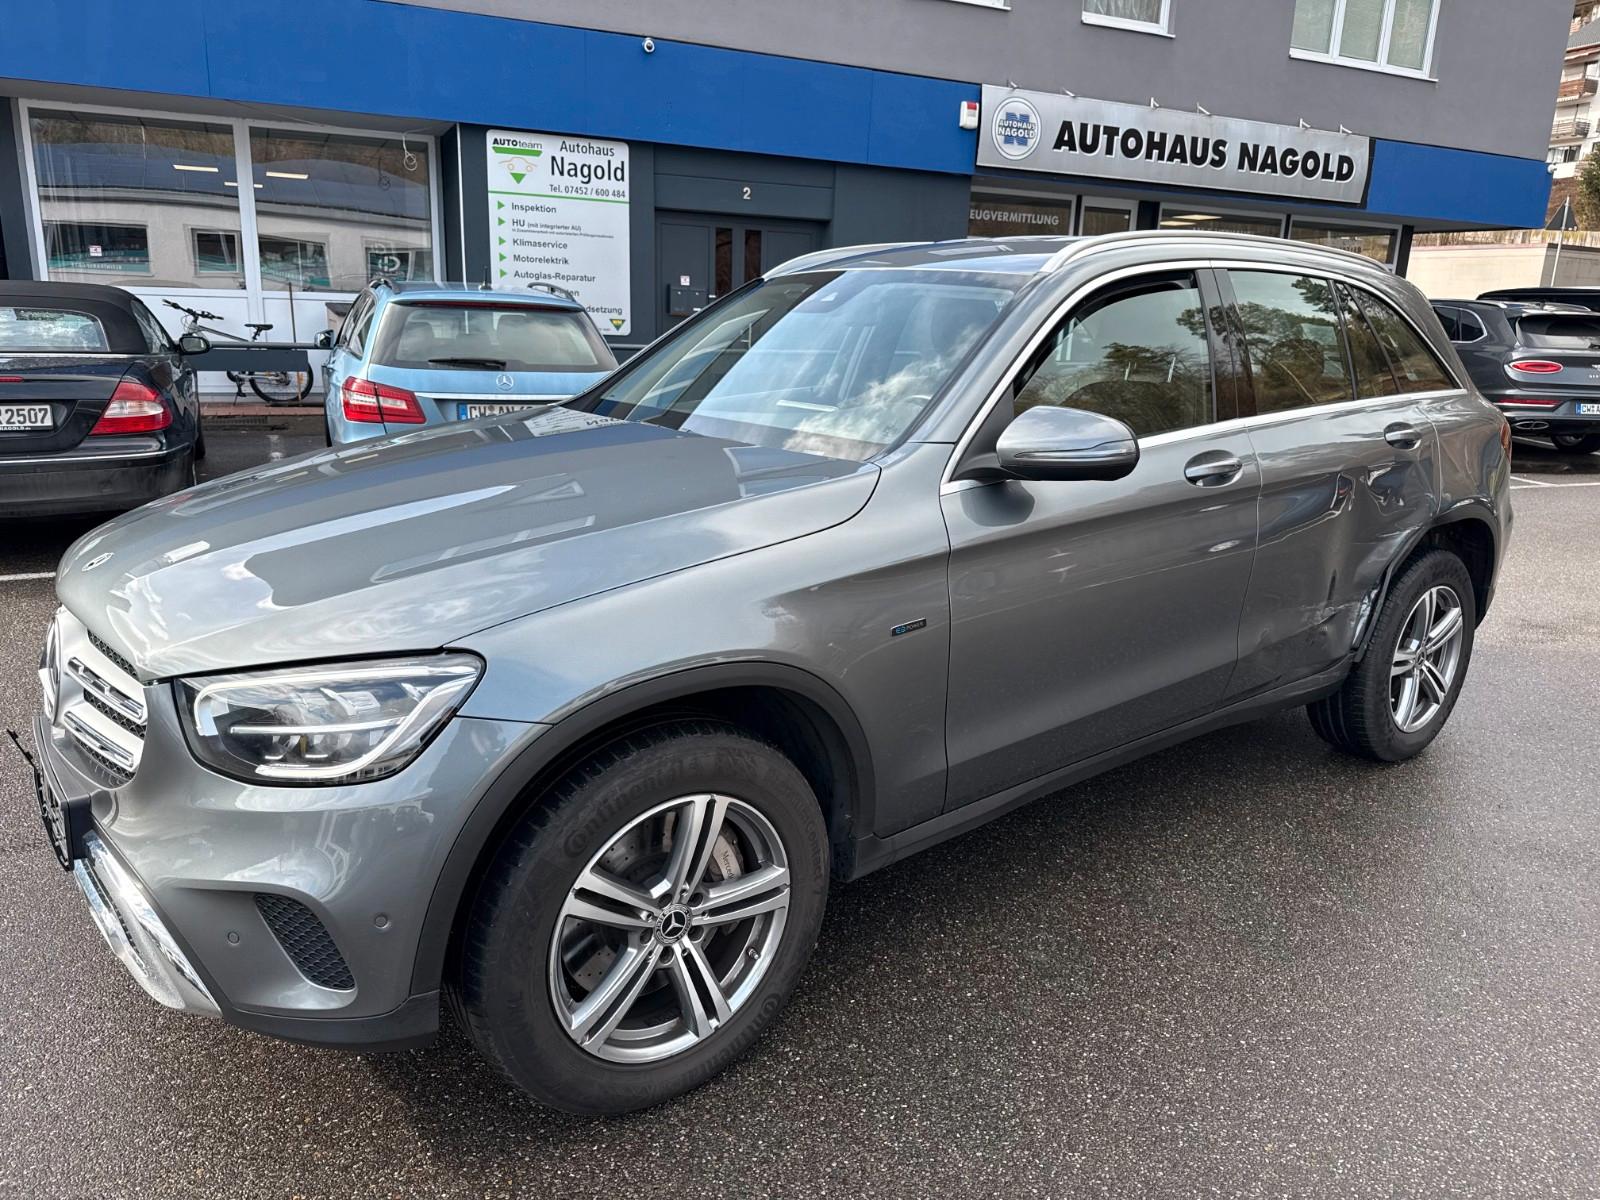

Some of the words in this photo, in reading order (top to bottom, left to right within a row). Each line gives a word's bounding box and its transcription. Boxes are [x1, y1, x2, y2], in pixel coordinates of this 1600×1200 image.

[999, 119, 1037, 130] AUTOHAUS
[998, 126, 1036, 139] NAGOLD
[560, 140, 615, 157] Autohaus
[1053, 120, 1228, 171] AUTOHAUS
[1237, 141, 1355, 183] NAGOLD
[550, 155, 625, 184] Nagold
[549, 184, 563, 193] Tel.
[564, 185, 588, 196] 07452
[595, 188, 610, 197] 600
[612, 189, 626, 198] 484
[743, 186, 751, 200] 2
[511, 202, 557, 214] Inspektion
[512, 218, 526, 228] HU
[969, 209, 1060, 226] EUGVERMITTLUNG
[512, 238, 568, 250] Klimaservice
[513, 254, 570, 265] Motorelektrik
[513, 270, 596, 282] Autoglas-Reparatur
[4, 407, 49, 425] 2507
